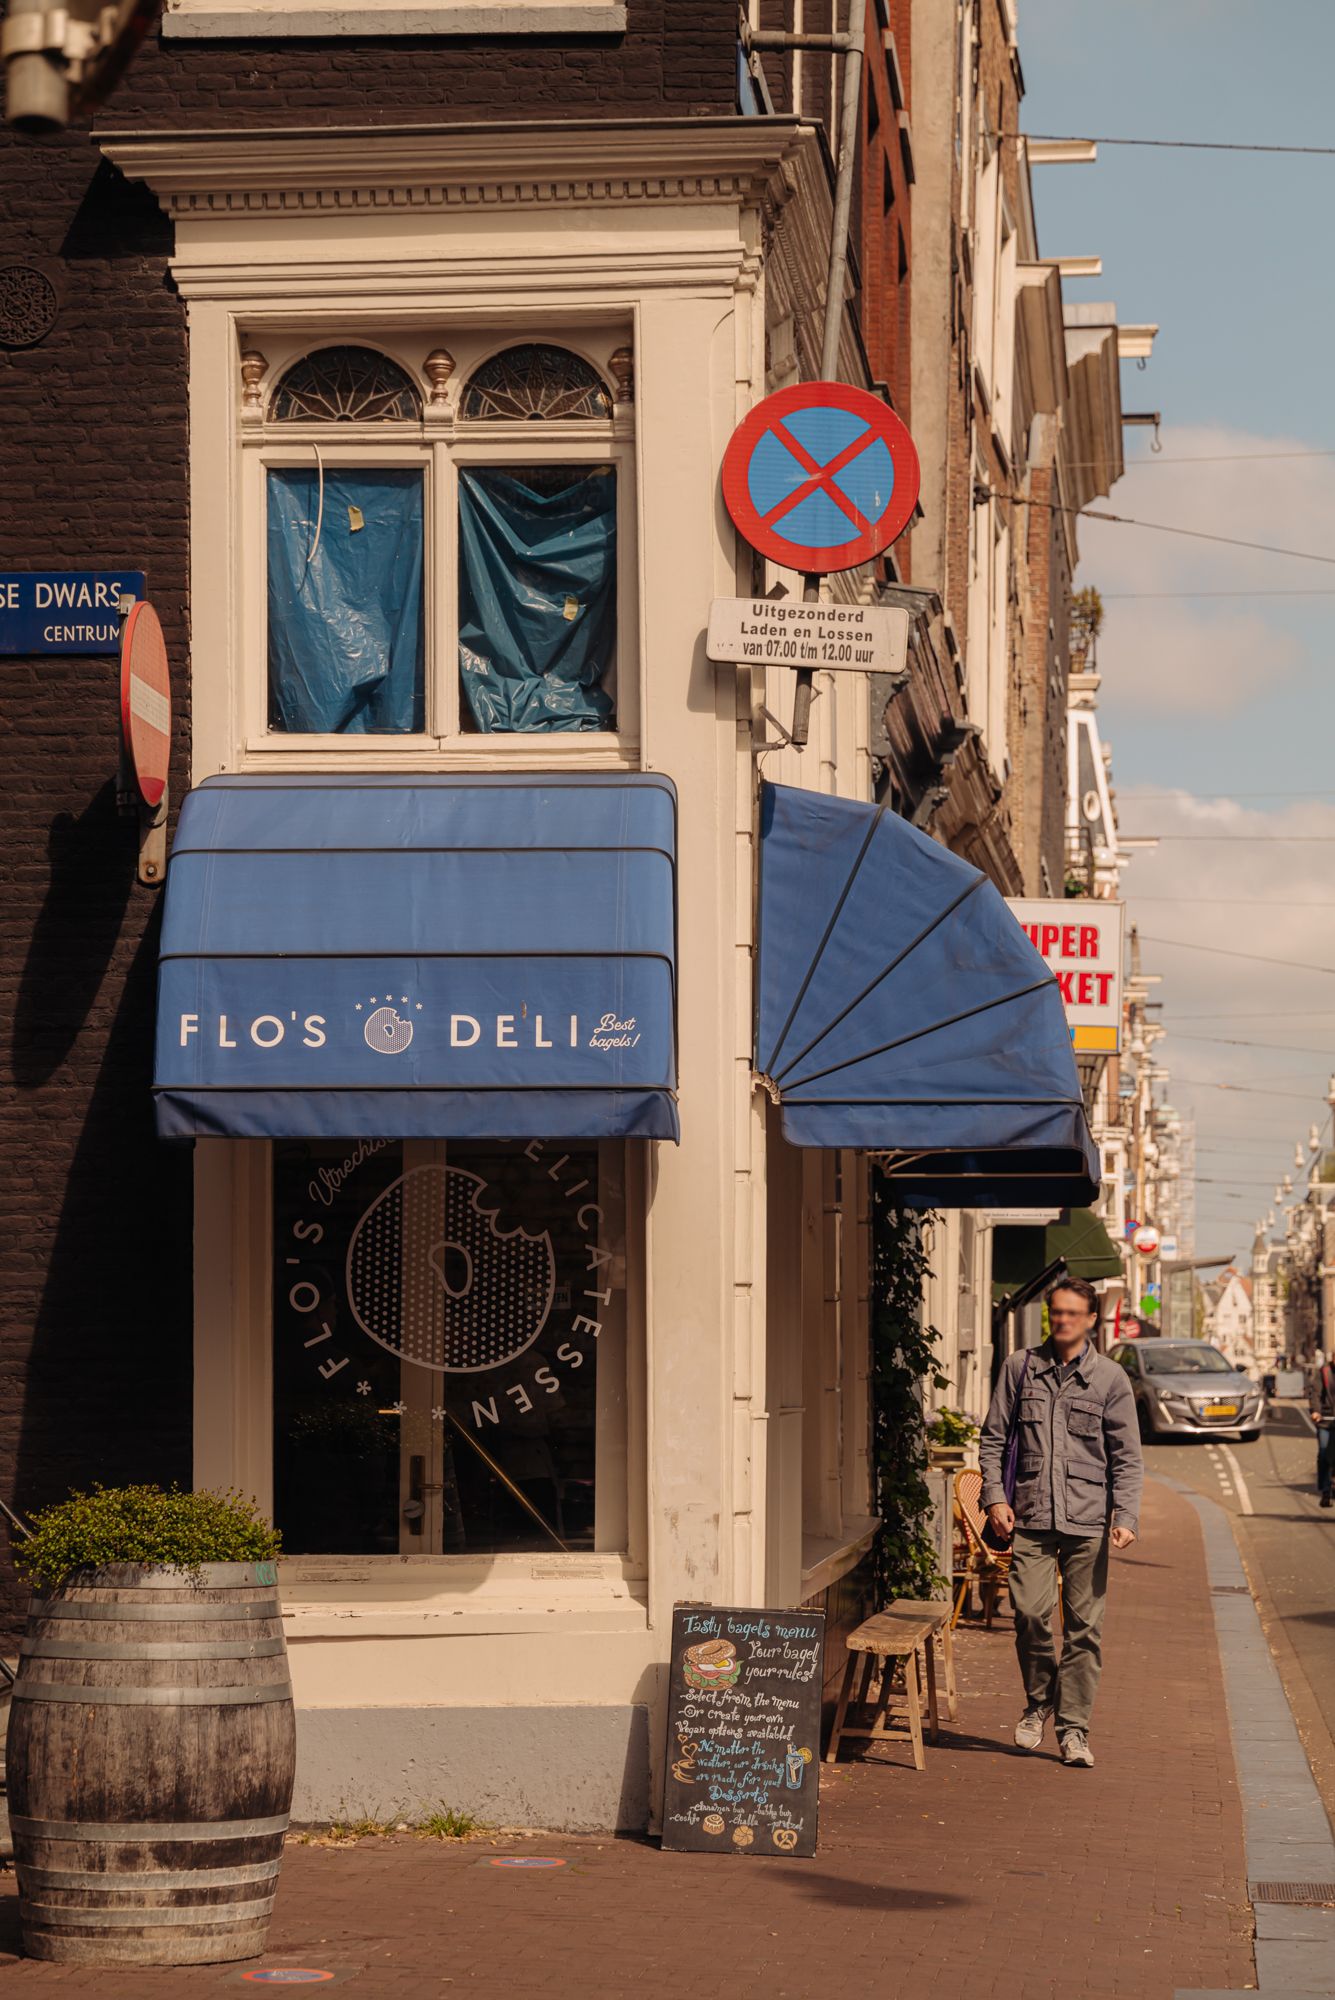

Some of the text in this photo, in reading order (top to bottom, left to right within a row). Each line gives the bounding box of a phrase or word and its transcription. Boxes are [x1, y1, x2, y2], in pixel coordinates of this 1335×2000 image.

[35, 582, 121, 609] DWARS
[752, 604, 864, 623] Uitgezonderd
[43, 625, 120, 642] CENTRUM
[740, 621, 873, 642] Laden en Lossen
[743, 640, 874, 663] van 07.00 t/m 12.00 uur
[180, 1010, 578, 1048] FLO'S DELI
[593, 1013, 636, 1034] Best
[589, 1033, 641, 1051] bagels!
[472, 1138, 612, 1428] ELICATESSEN
[286, 1219, 350, 1380] FLO'S
[683, 1615, 817, 1641] Tasty bagels menu
[748, 1640, 820, 1667] Your bagel
[744, 1666, 776, 1685] your
[716, 1689, 752, 1707] from
[754, 1692, 770, 1707] the
[771, 1696, 800, 1711] menu
[707, 1706, 740, 1722] create
[744, 1714, 766, 1725] your
[766, 1715, 784, 1723] own
[708, 1721, 743, 1739] options
[751, 1741, 766, 1755] the
